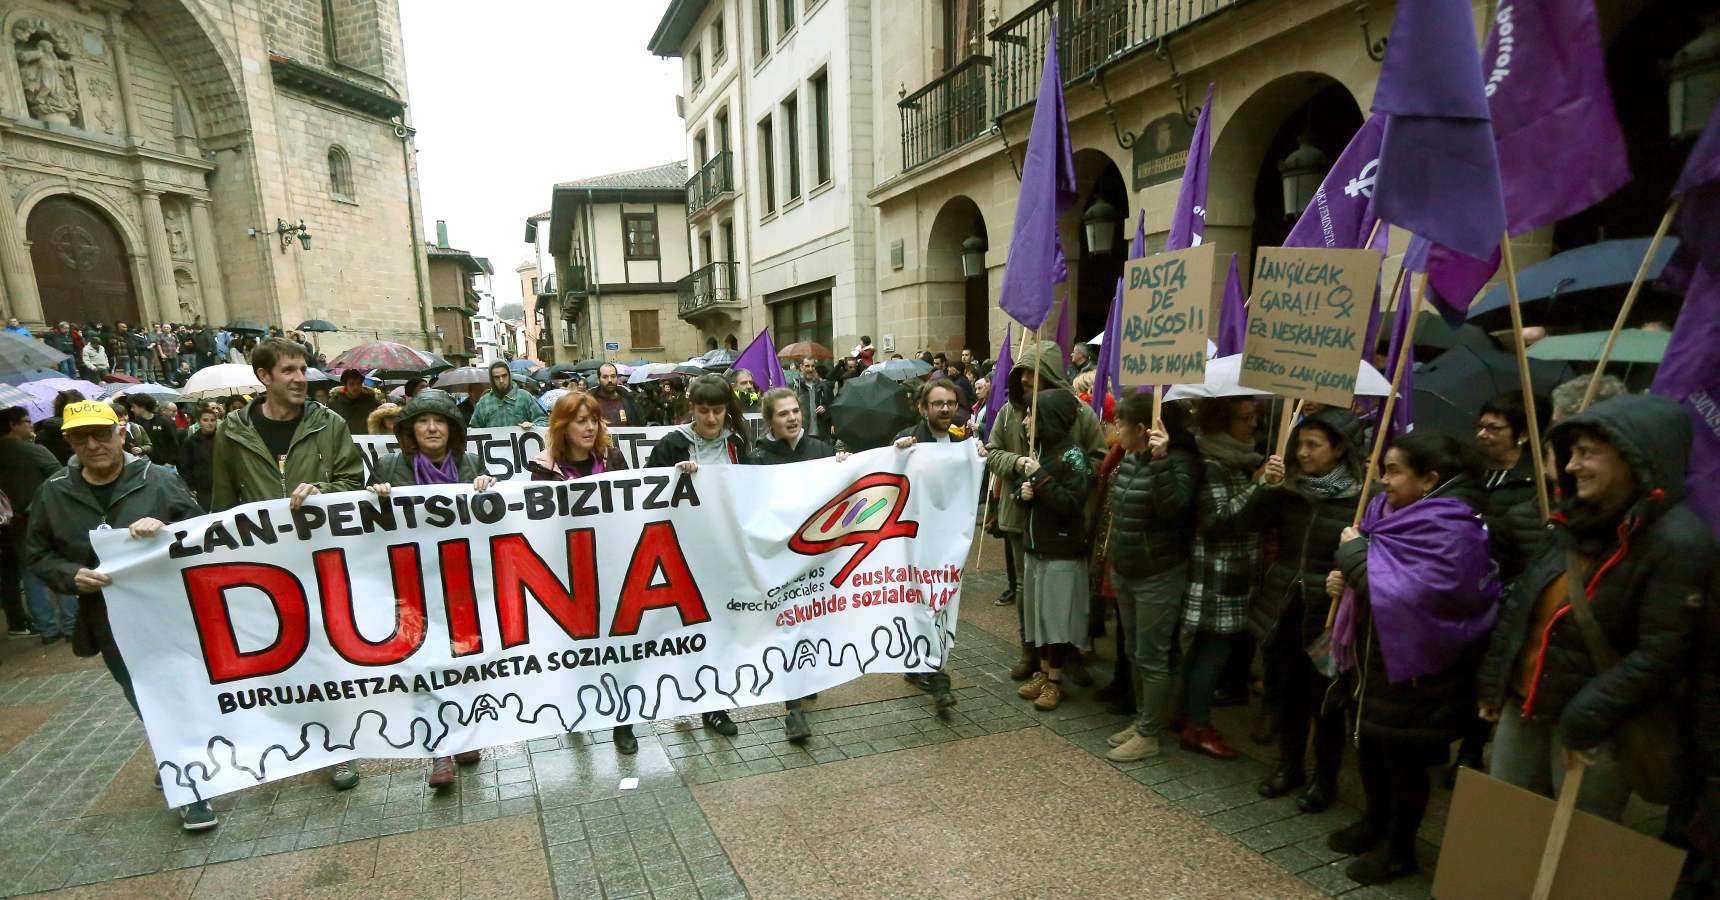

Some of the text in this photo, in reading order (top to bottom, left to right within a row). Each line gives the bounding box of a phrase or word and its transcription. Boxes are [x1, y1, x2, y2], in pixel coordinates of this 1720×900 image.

[1484, 5, 1514, 97] borroka
[1130, 259, 1187, 290] BASTA
[1147, 287, 1177, 313] DE
[1260, 289, 1321, 317] GARA!!
[1123, 306, 1204, 342] ABUSOS!!
[1271, 321, 1356, 351] NESKAMEAK
[1166, 351, 1206, 376] HOGAR
[168, 472, 701, 560] LAN-PENTSIO-BIZITZA
[180, 519, 712, 685] DUINA
[776, 593, 847, 628] eskubide
[852, 584, 926, 609] sozialen
[783, 582, 825, 602] sociales
[217, 632, 707, 715] BURUJABETZA ALDAKETA SOZIALERAKO
